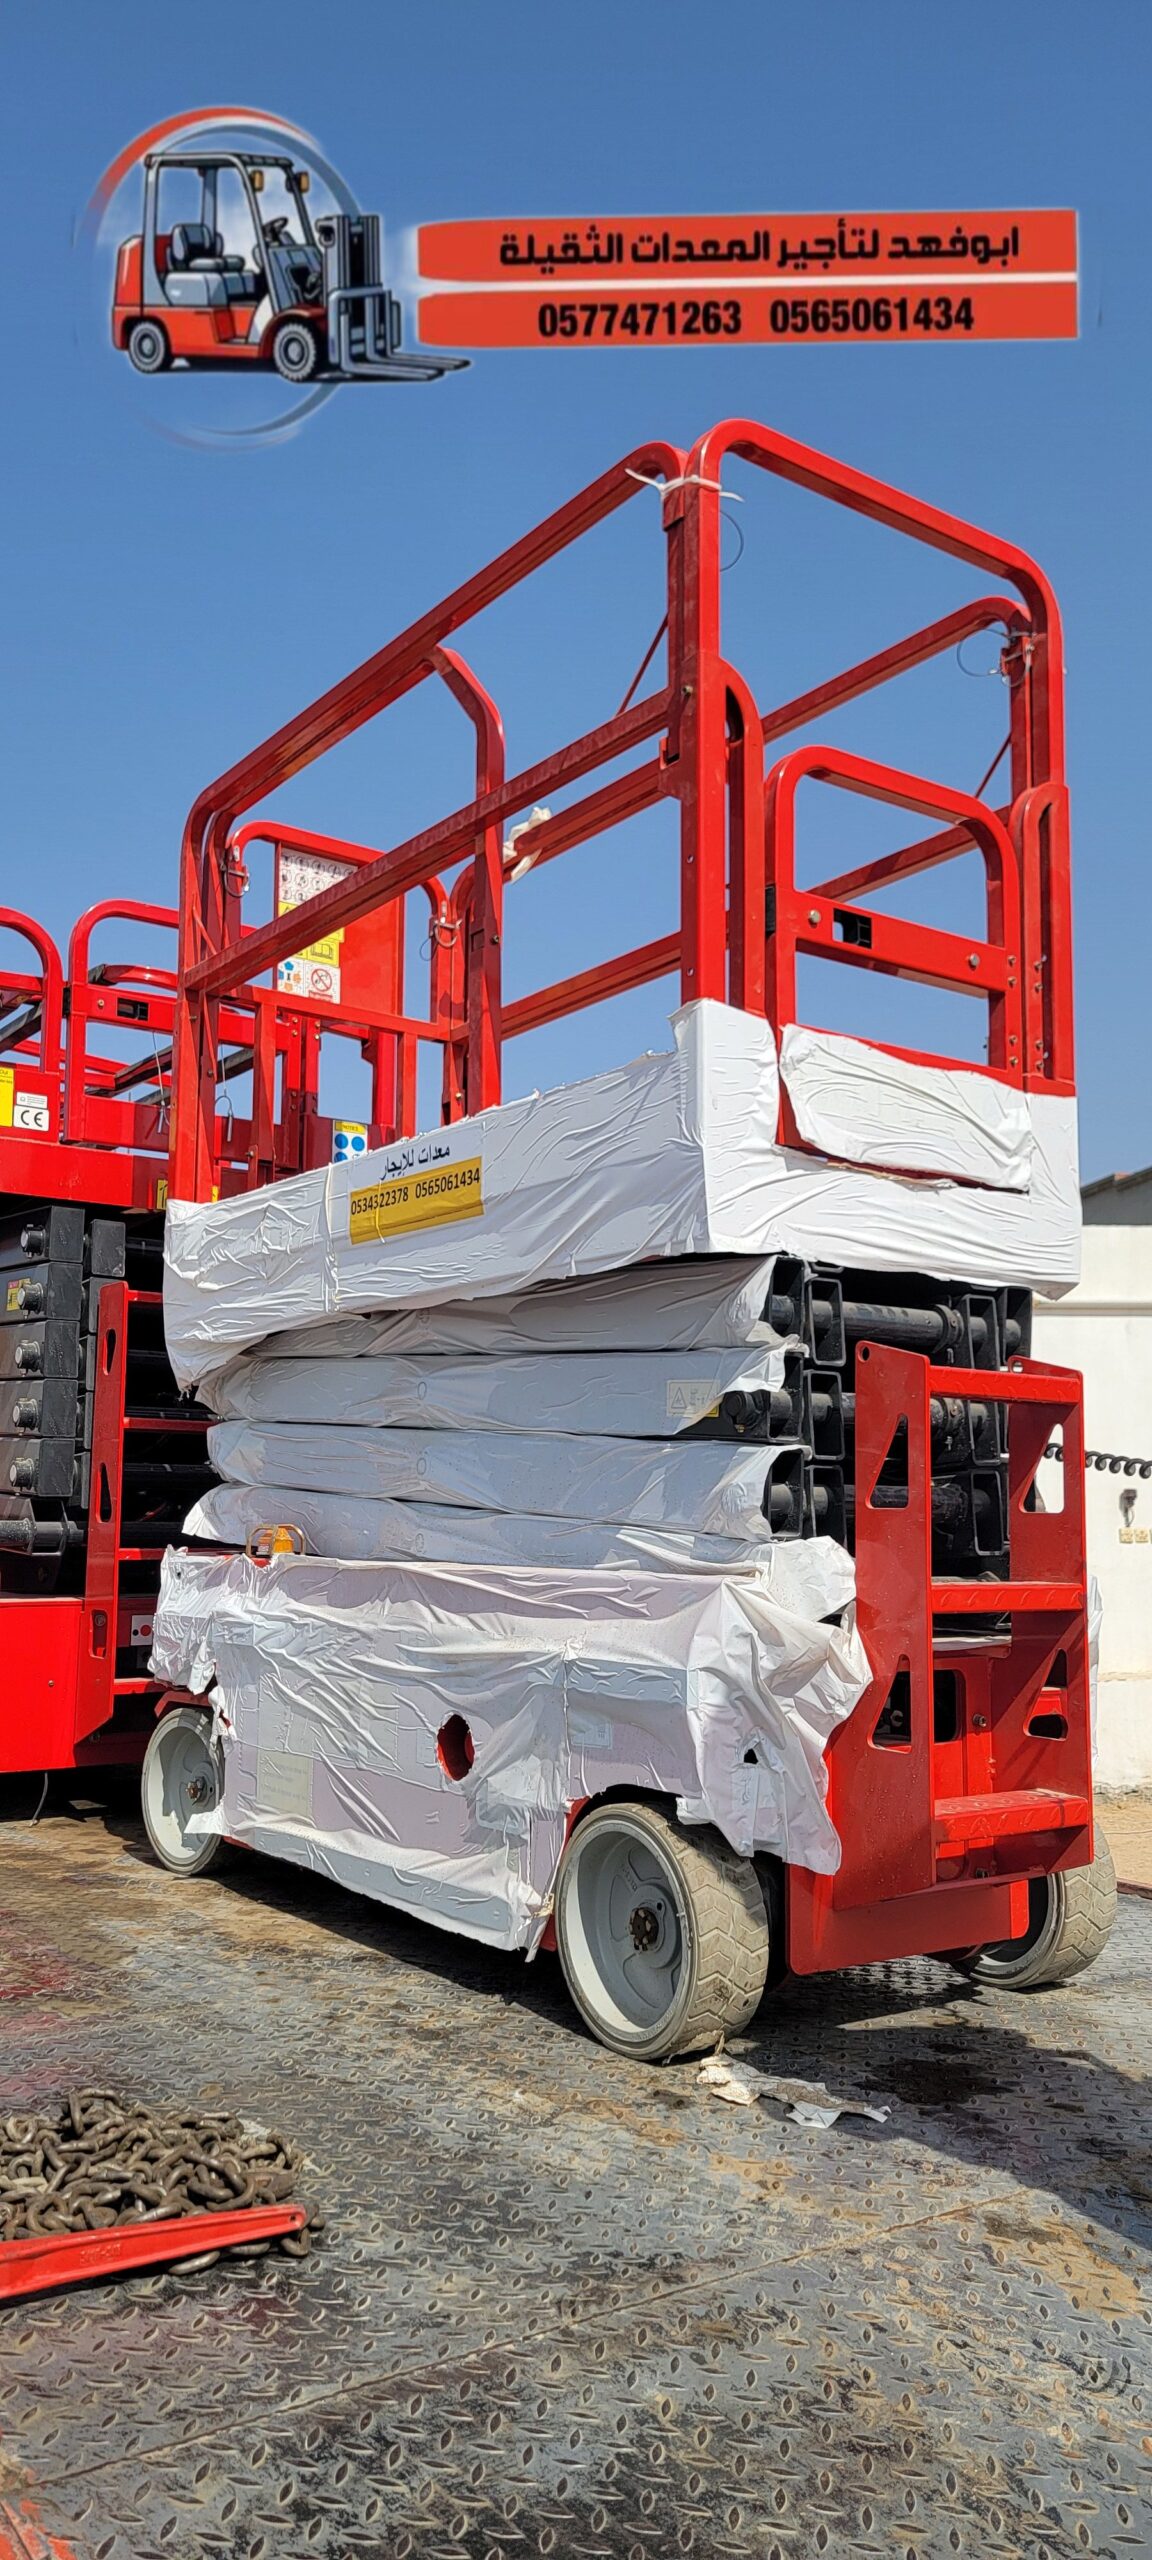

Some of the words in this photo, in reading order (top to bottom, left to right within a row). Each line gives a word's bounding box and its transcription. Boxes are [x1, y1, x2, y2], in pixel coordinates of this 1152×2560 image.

[20, 1109, 44, 1128] CE
[418, 1143, 450, 1164] معدات
[351, 1186, 409, 1216] 0534322378
[415, 1167, 480, 1199] 0565061434
